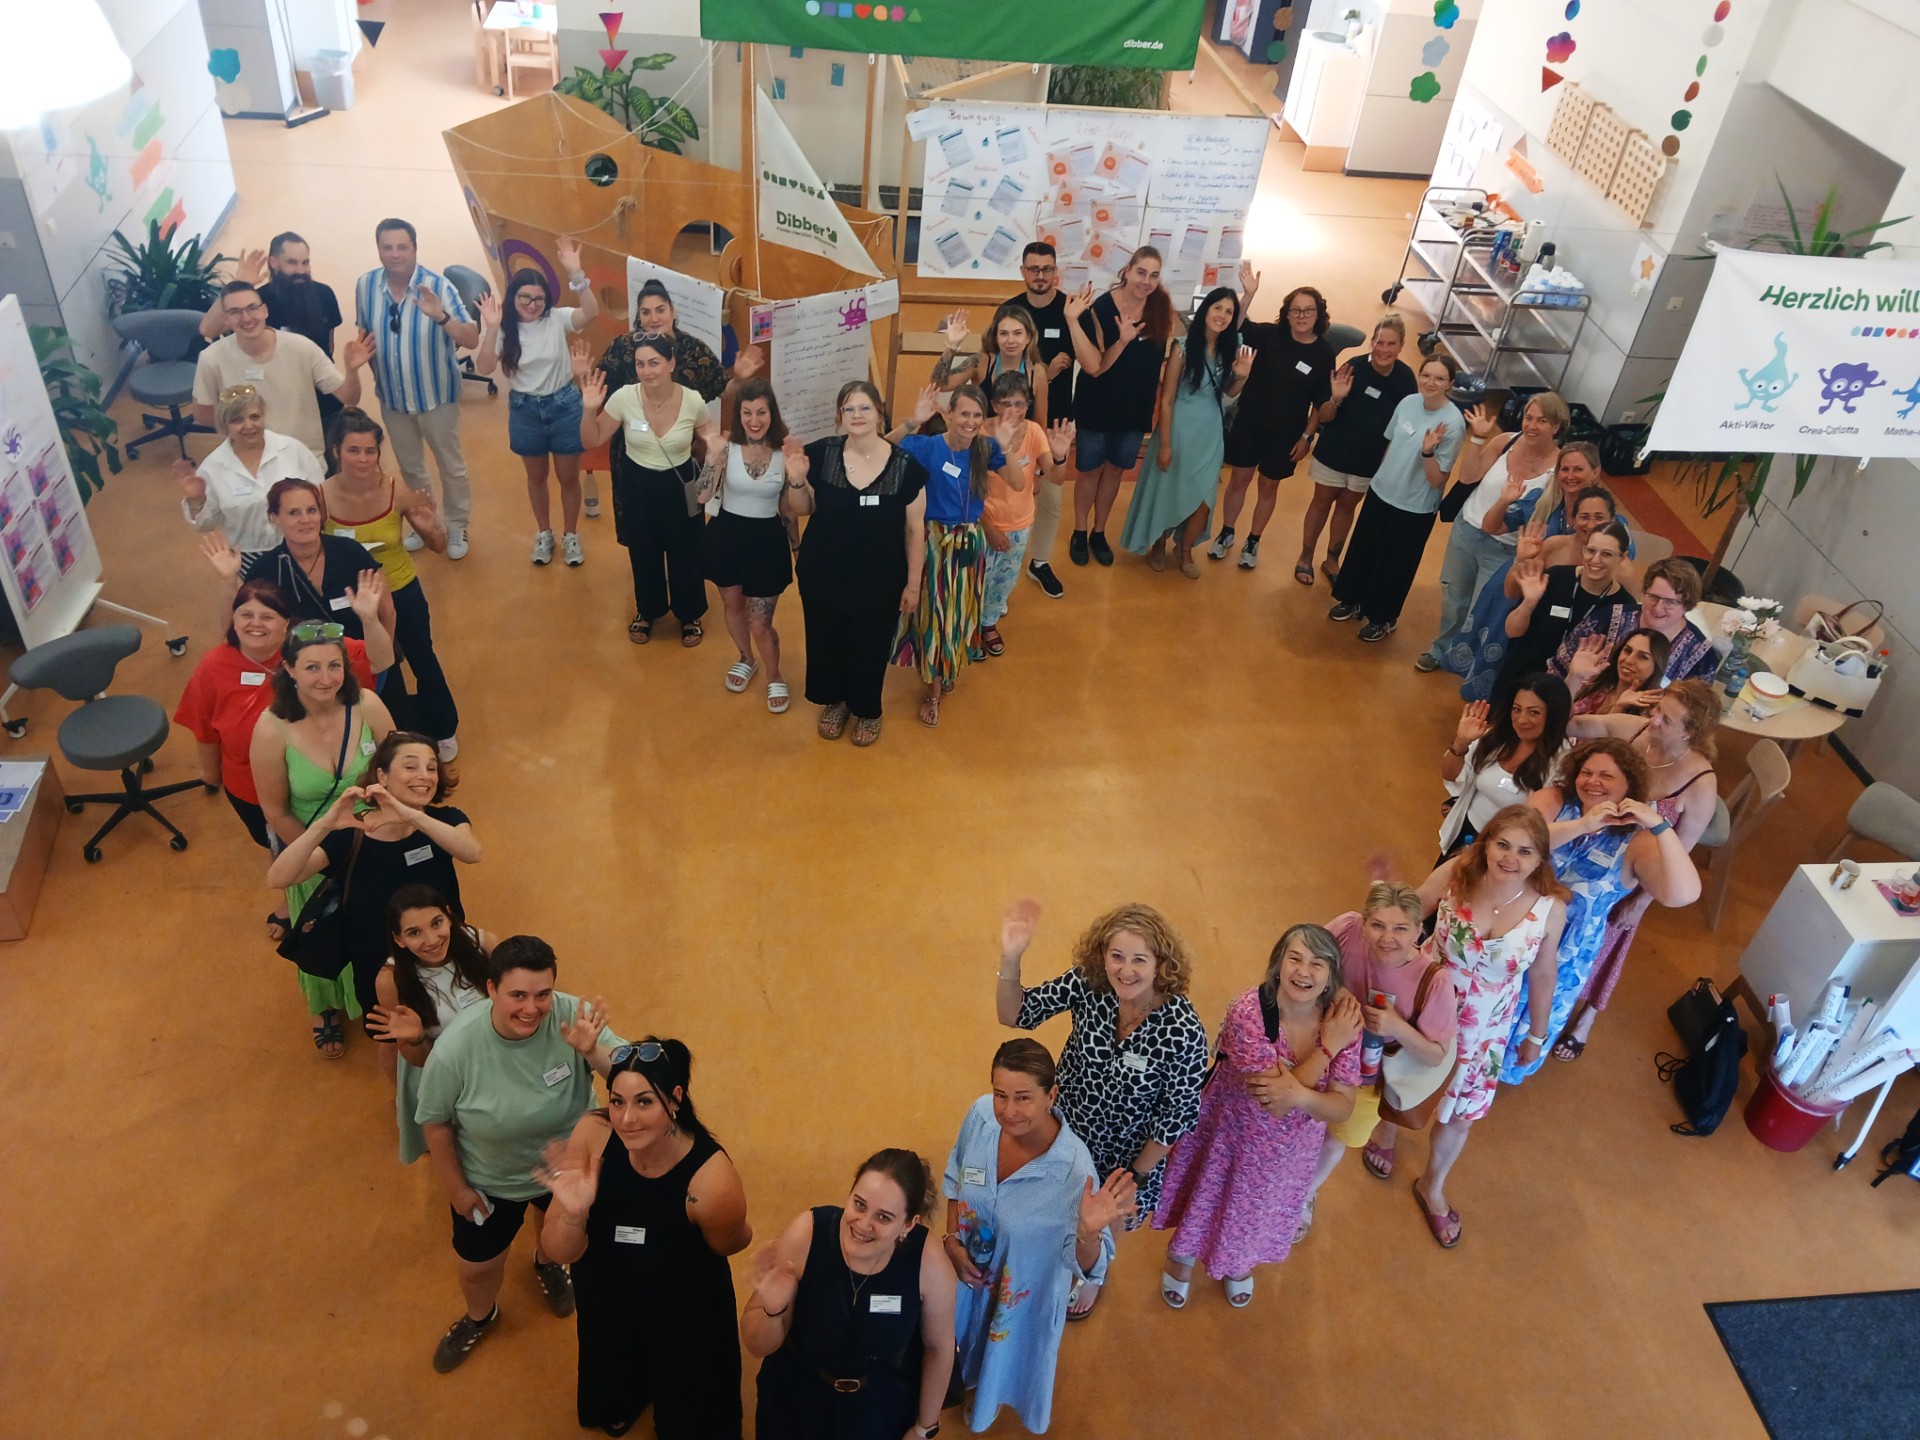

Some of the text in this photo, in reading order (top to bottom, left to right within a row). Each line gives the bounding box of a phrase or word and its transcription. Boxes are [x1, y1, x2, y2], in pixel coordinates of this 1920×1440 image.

[1123, 39, 1164, 50] dibber.de
[776, 210, 825, 236] Dibber
[1759, 285, 1871, 312] Herzlich
[1719, 419, 1775, 431] Akti-Viktor
